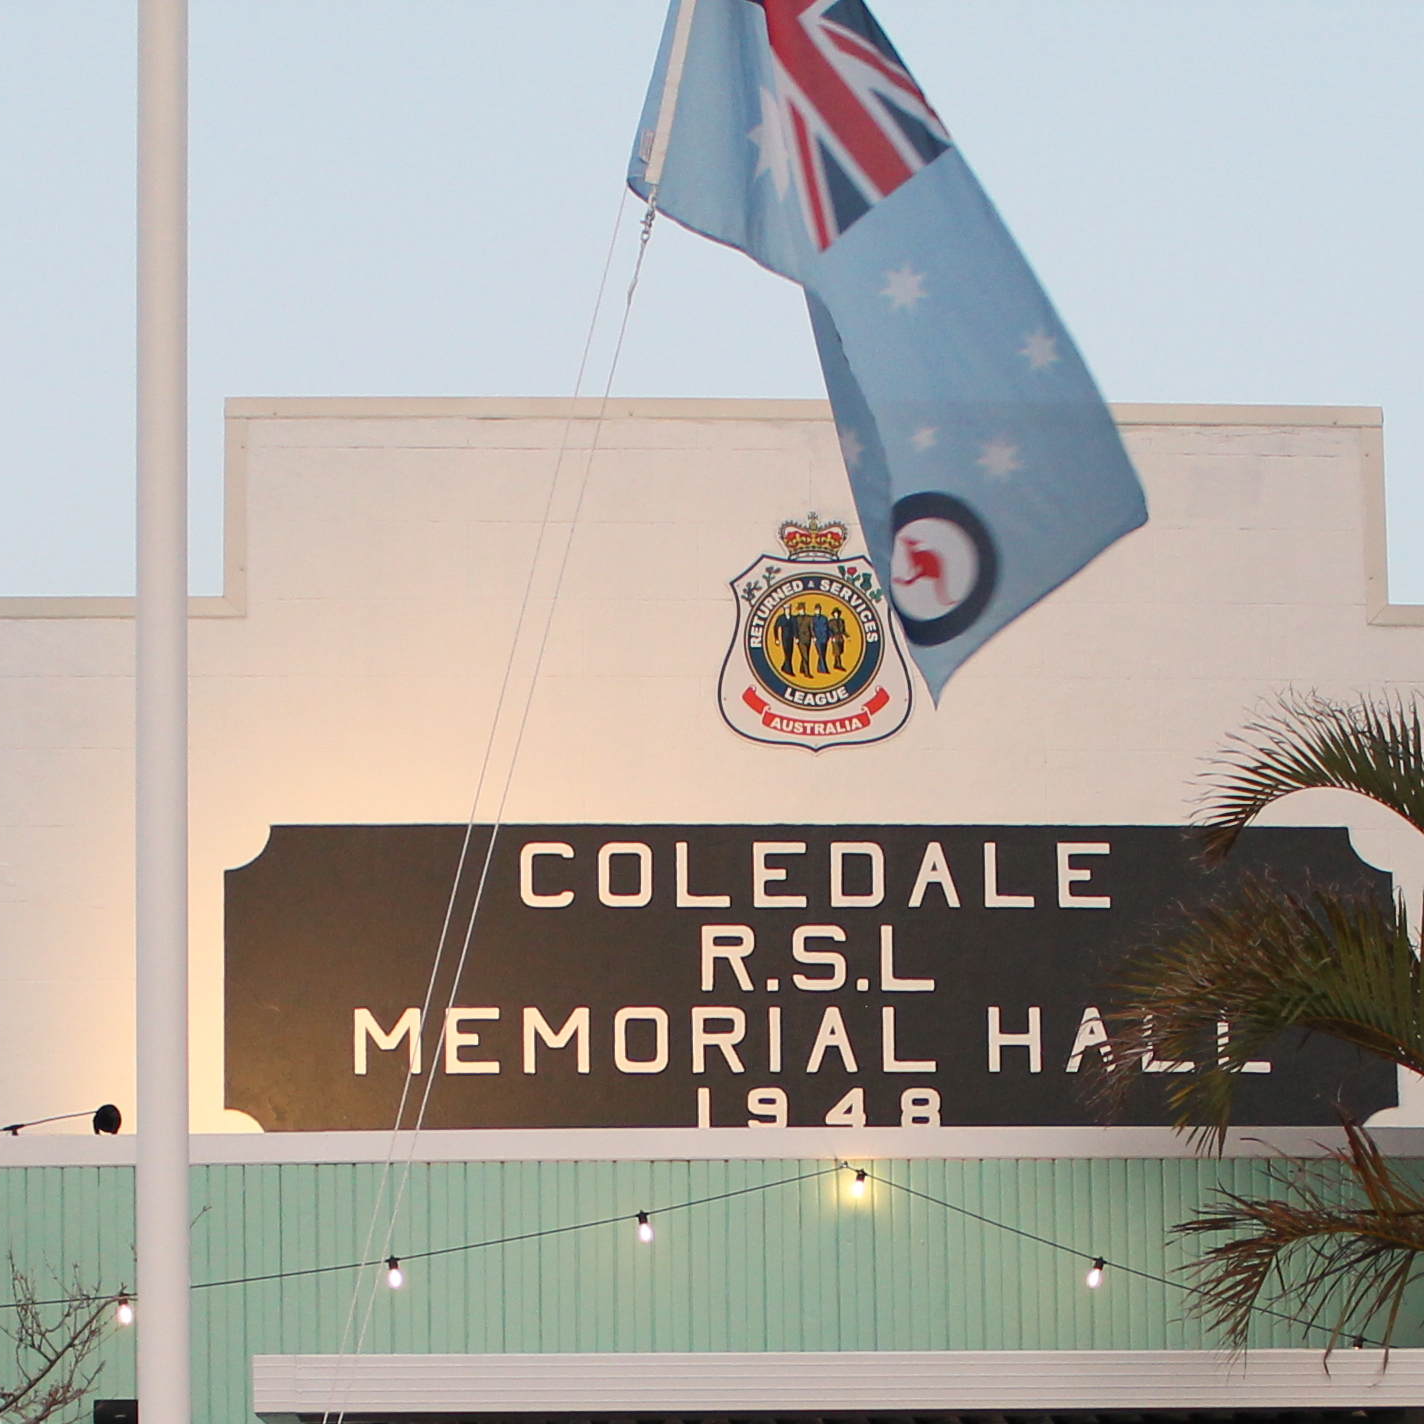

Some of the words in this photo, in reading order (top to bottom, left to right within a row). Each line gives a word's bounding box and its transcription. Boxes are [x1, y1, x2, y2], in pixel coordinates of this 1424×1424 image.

[750, 579, 804, 648] RETURNED
[819, 579, 879, 643] SERVICES
[770, 716, 863, 735] AUSTRALIA
[784, 686, 850, 706] LEAGUE
[520, 841, 1111, 908] COLEDALE
[700, 924, 936, 992] R.S.L
[353, 1005, 937, 1075] MEMORIAL
[697, 1087, 941, 1129] 1948
